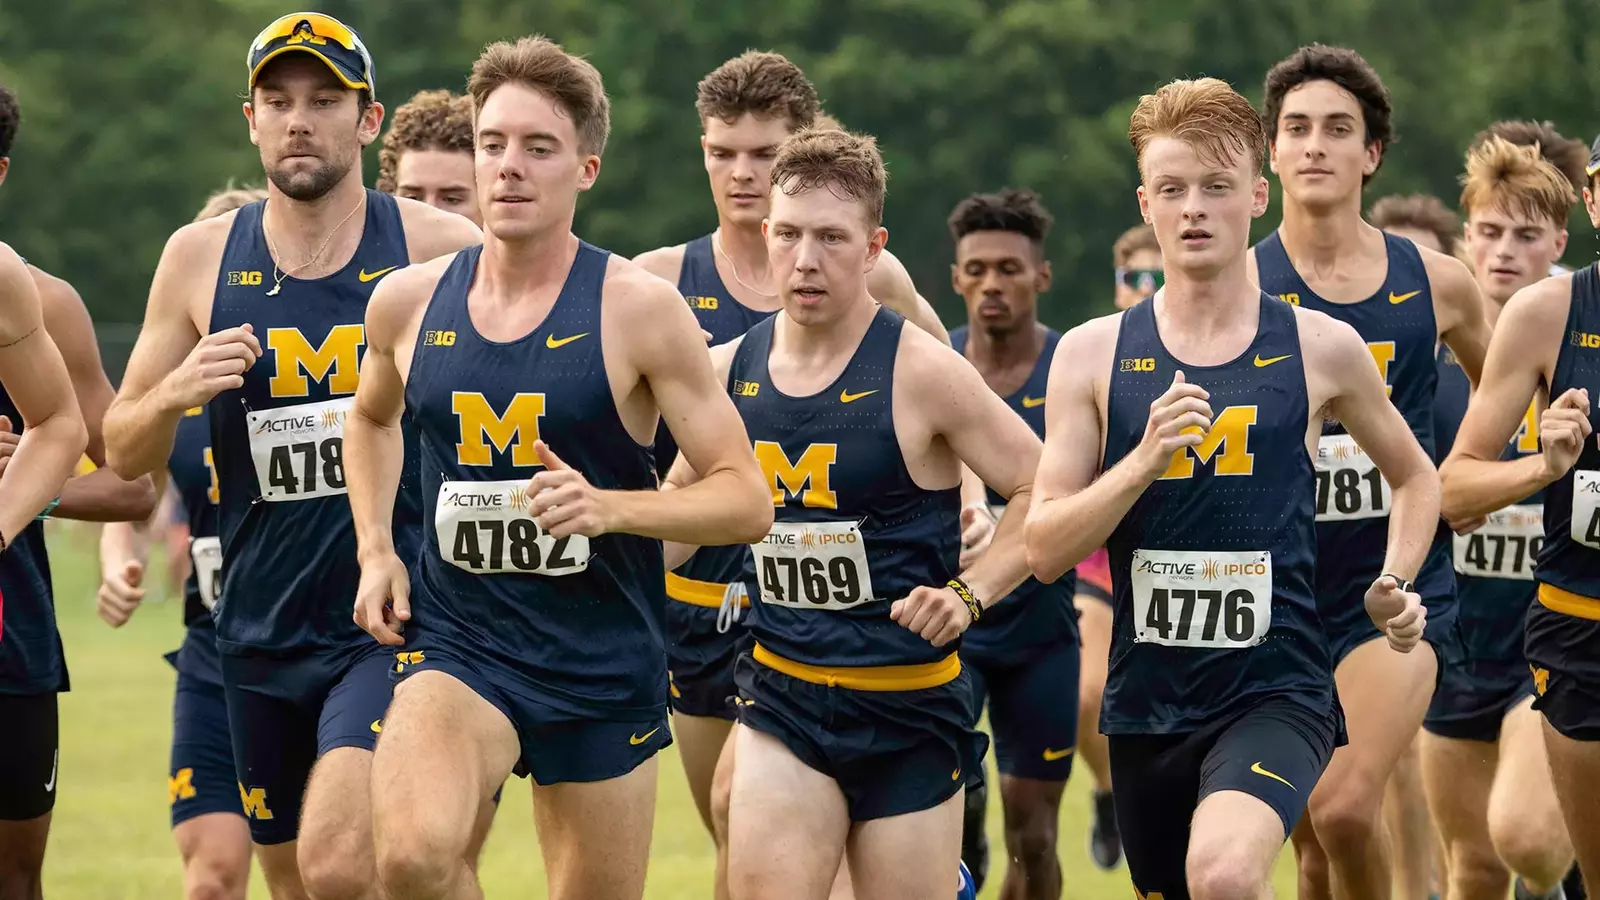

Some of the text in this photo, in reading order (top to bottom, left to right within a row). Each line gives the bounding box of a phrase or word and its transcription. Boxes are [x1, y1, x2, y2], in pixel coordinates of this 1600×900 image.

[267, 324, 365, 398] M
[255, 415, 315, 435] ACTIVE
[452, 391, 546, 468] M
[1157, 405, 1258, 480] M
[269, 436, 346, 495] 478
[753, 440, 838, 510] M
[1315, 466, 1384, 514] 781
[443, 492, 503, 507] ACTIVE
[761, 533, 857, 545] CTIVE IPICO
[762, 556, 861, 605] 4769
[1137, 560, 1266, 576] ACTIVE IPICO
[1146, 588, 1255, 642] 4776
